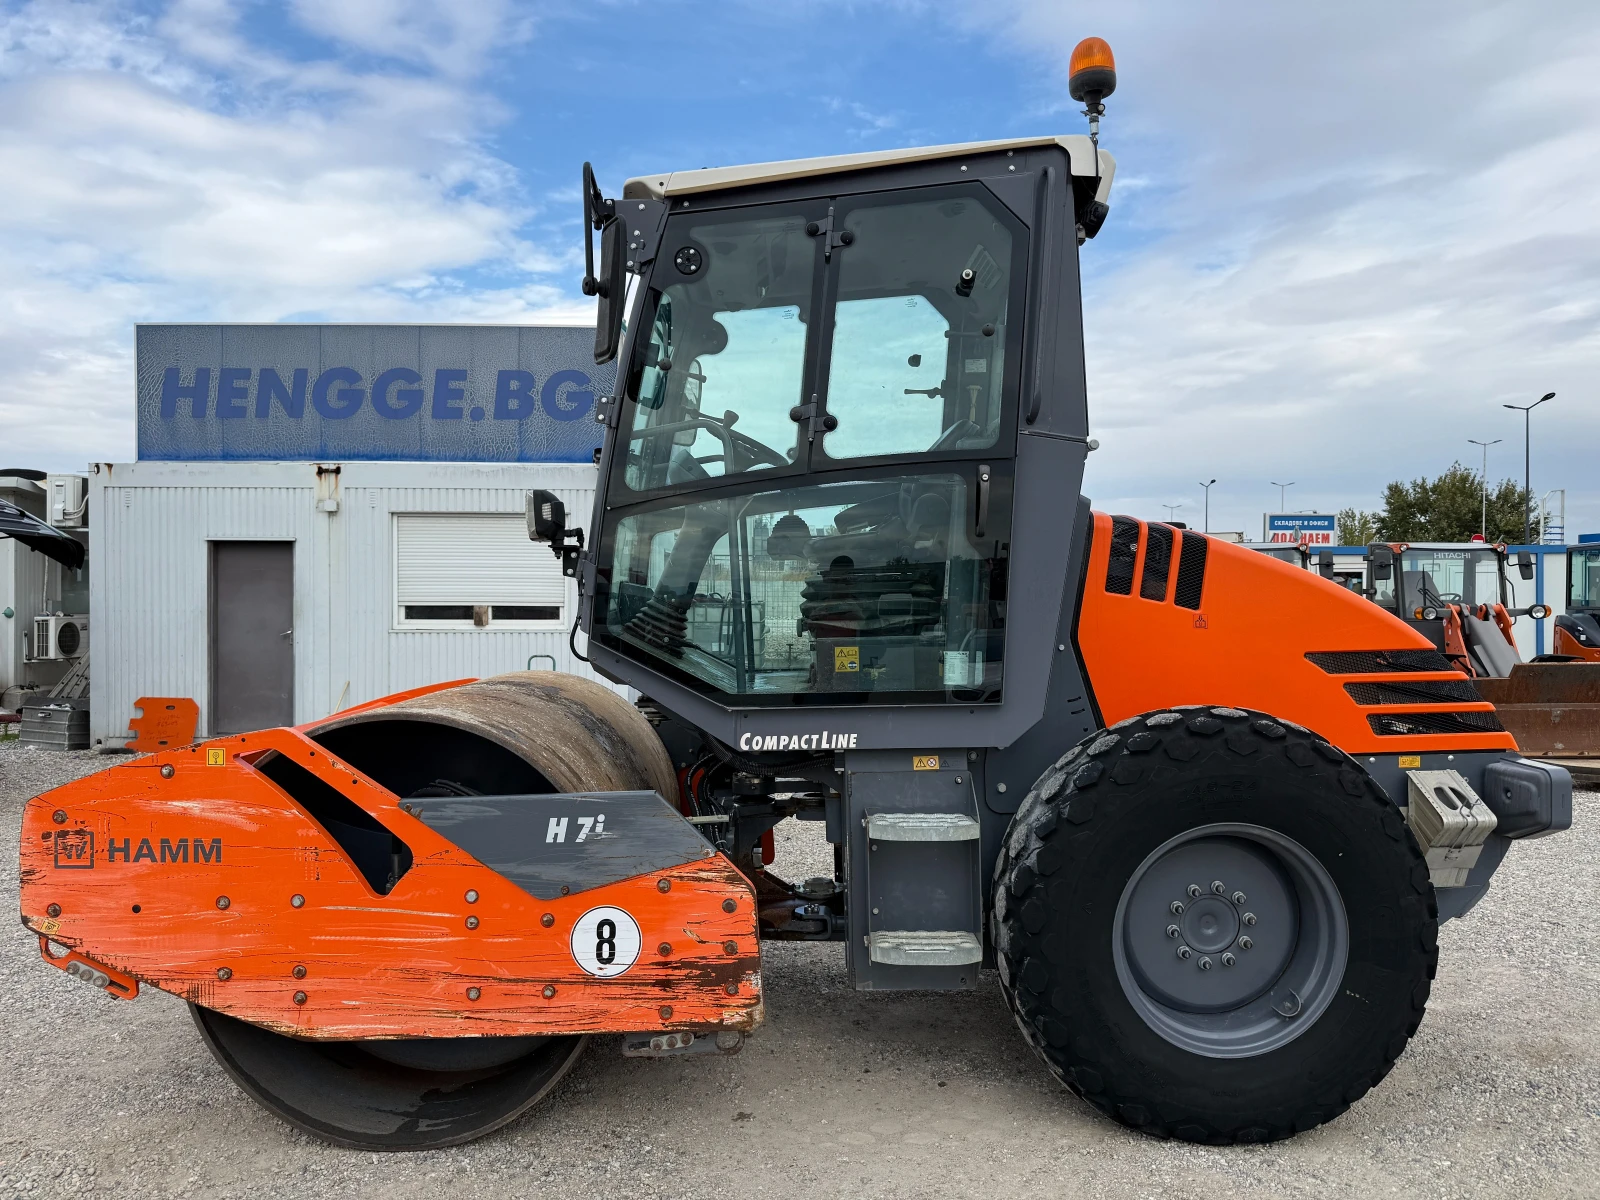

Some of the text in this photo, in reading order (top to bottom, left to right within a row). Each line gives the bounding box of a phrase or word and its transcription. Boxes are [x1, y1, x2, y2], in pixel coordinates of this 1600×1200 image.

[160, 366, 594, 421] HENGGE.BG
[545, 817, 569, 843] H
[108, 837, 222, 863] HAMM
[595, 918, 616, 965] 8
